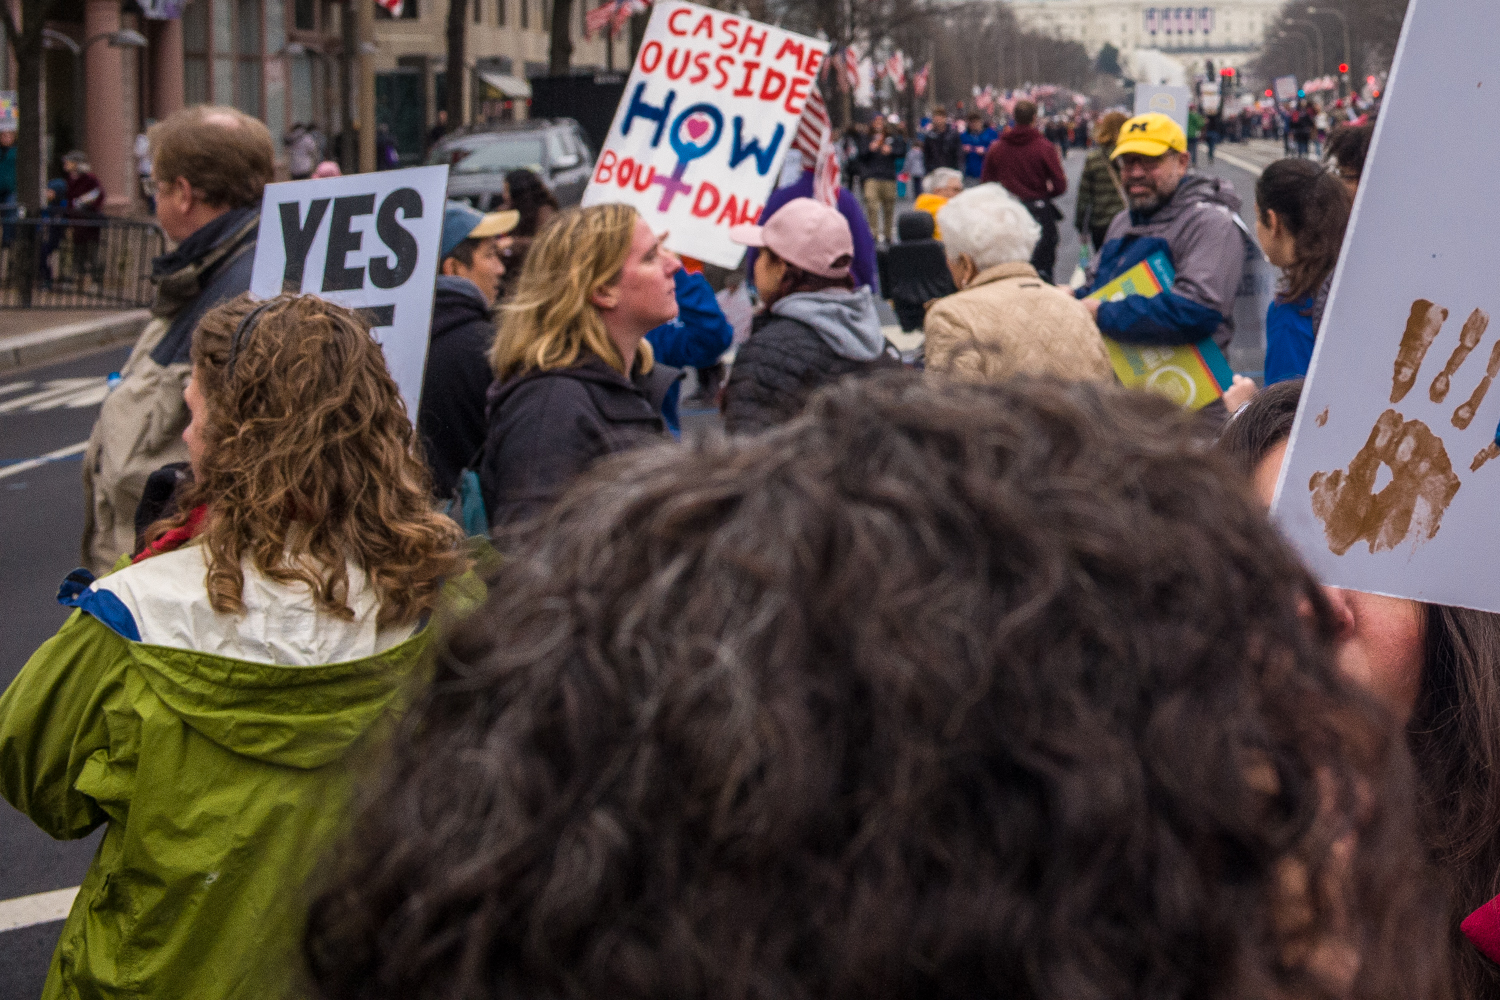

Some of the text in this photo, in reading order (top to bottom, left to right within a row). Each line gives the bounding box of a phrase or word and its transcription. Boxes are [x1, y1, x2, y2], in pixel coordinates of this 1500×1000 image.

[639, 40, 810, 115] OUSSIDE
[667, 7, 824, 77] CASH ME
[620, 80, 786, 176] HOW
[278, 187, 424, 296] YES
[690, 180, 765, 228] DAH
